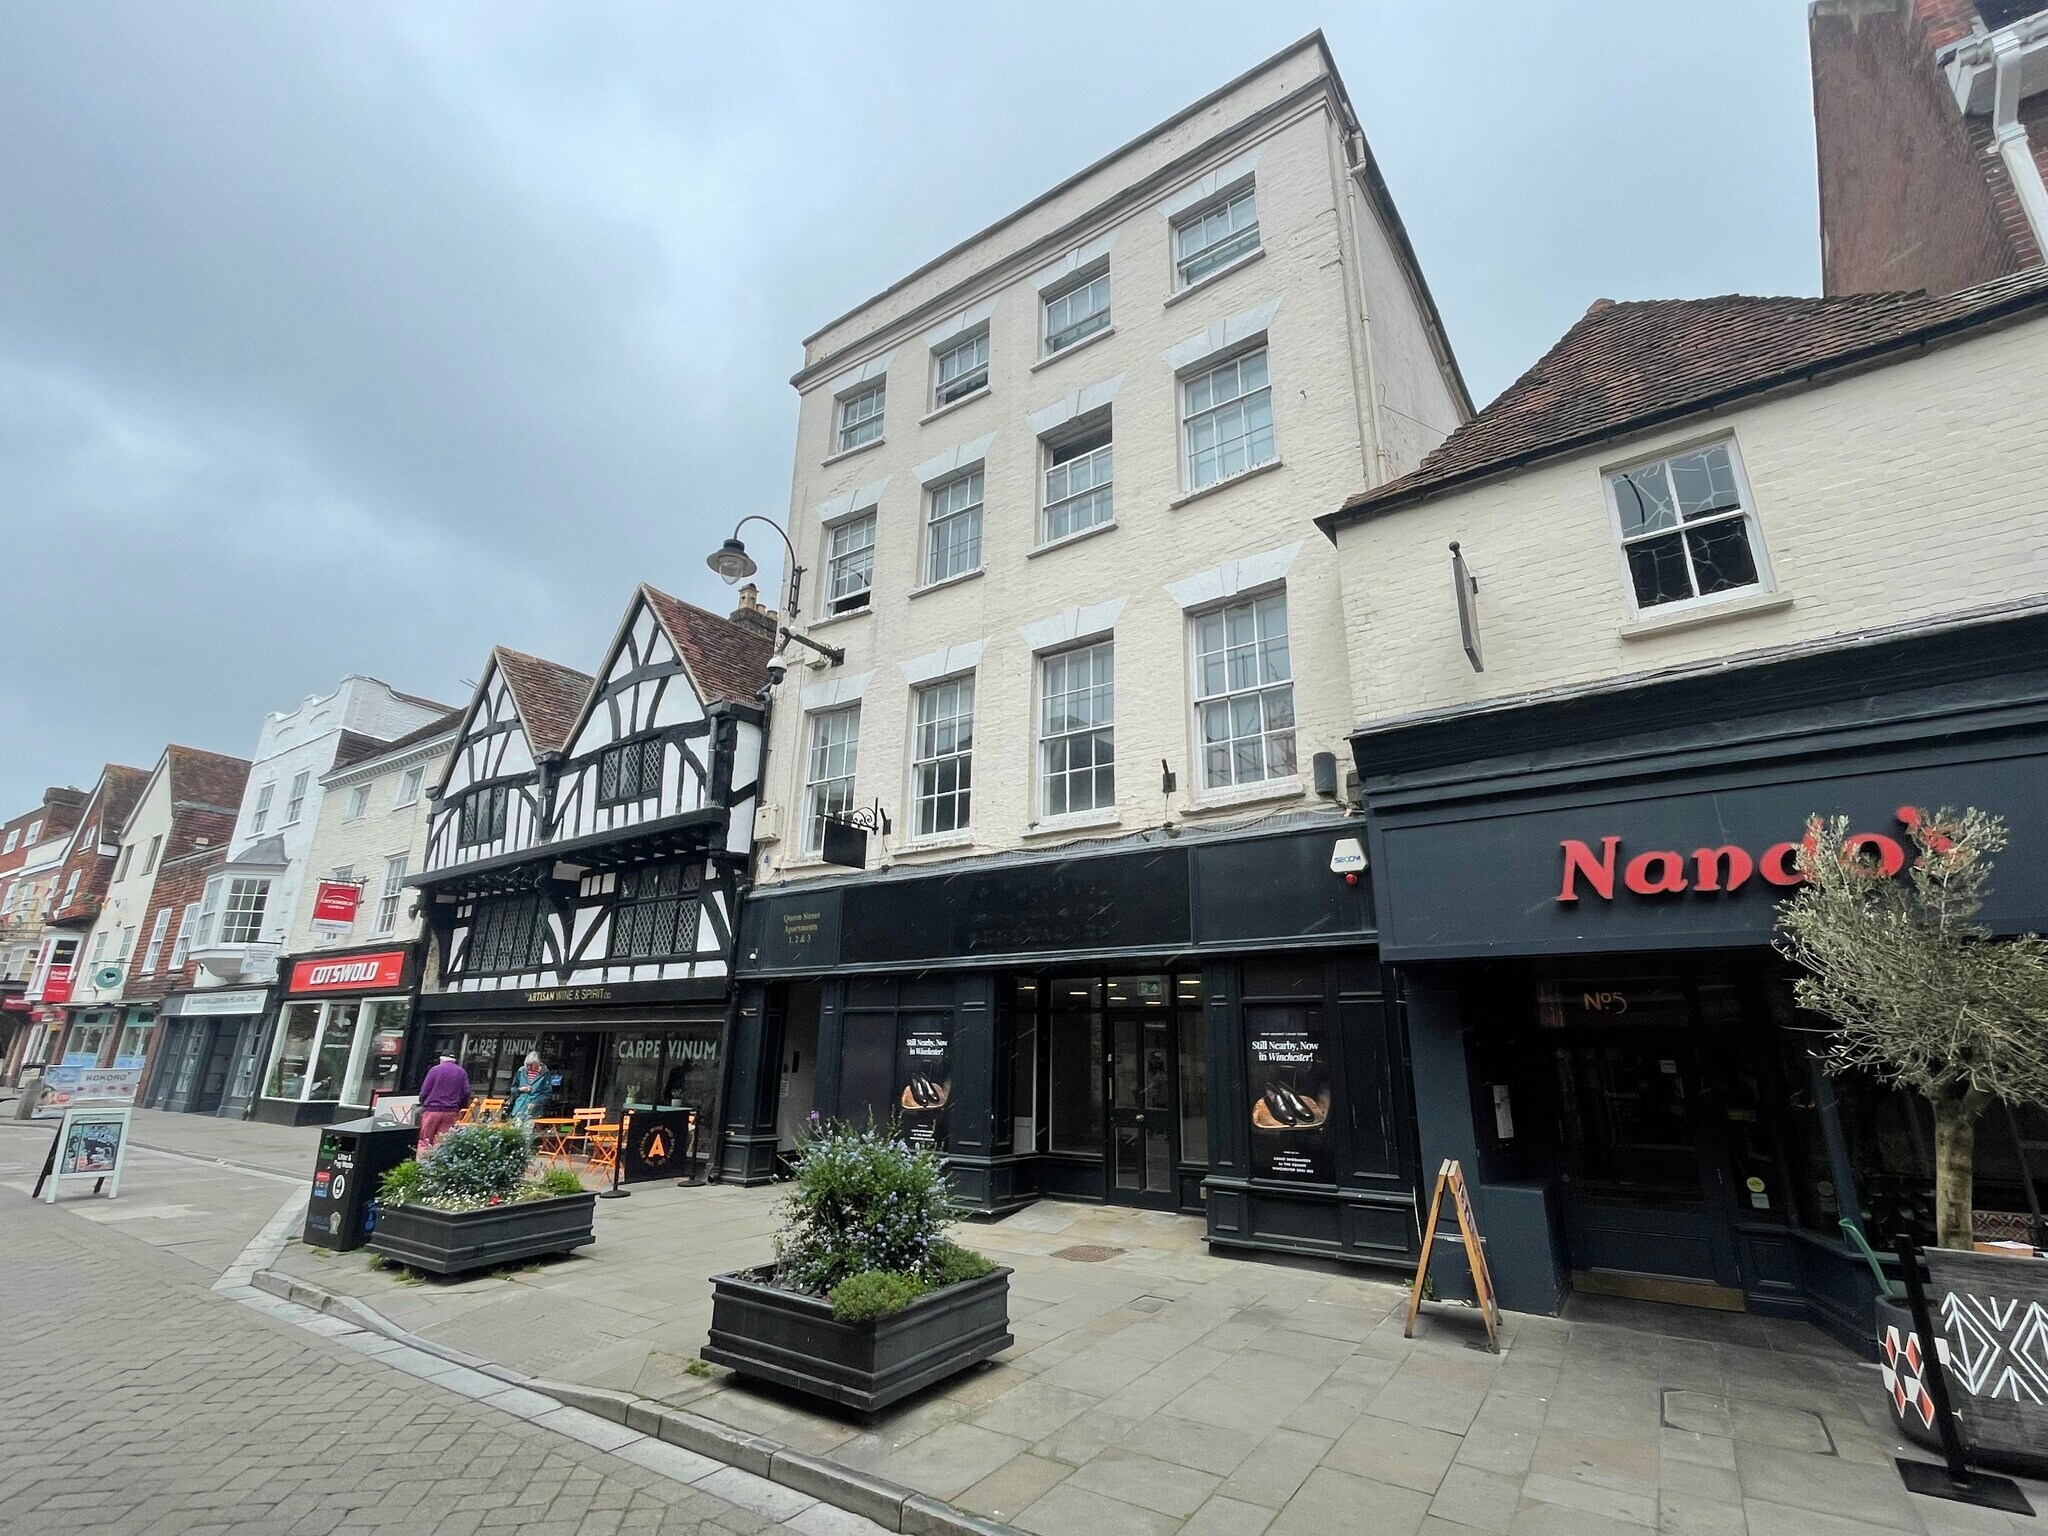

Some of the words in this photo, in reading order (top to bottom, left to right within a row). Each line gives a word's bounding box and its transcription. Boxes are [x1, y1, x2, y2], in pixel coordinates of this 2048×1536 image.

[1334, 855, 1361, 864] SECOM
[320, 899, 354, 907] COTSWOLD
[783, 914, 802, 924] Queen
[803, 911, 820, 920] Street
[785, 923, 818, 934] Apartments
[309, 962, 379, 985] COTSWOLD
[528, 991, 555, 1002] ARTISAN
[555, 990, 574, 1001] WINE
[574, 989, 580, 1000] &
[581, 988, 604, 1000] SPIRIT
[467, 1039, 497, 1055] CARPE
[502, 1039, 538, 1056] VINUM
[917, 1039, 936, 1047] Nearby,
[1252, 1041, 1268, 1050] Still
[1269, 1041, 1299, 1051] Nearby,
[1300, 1041, 1319, 1050] Now
[618, 1040, 661, 1059] CARPE
[668, 1040, 717, 1060] VINUM
[909, 1047, 916, 1055] in
[916, 1047, 944, 1056] Winchester!
[1258, 1052, 1267, 1061] in
[1269, 1052, 1313, 1062] Winchester!
[647, 1133, 665, 1157] A
